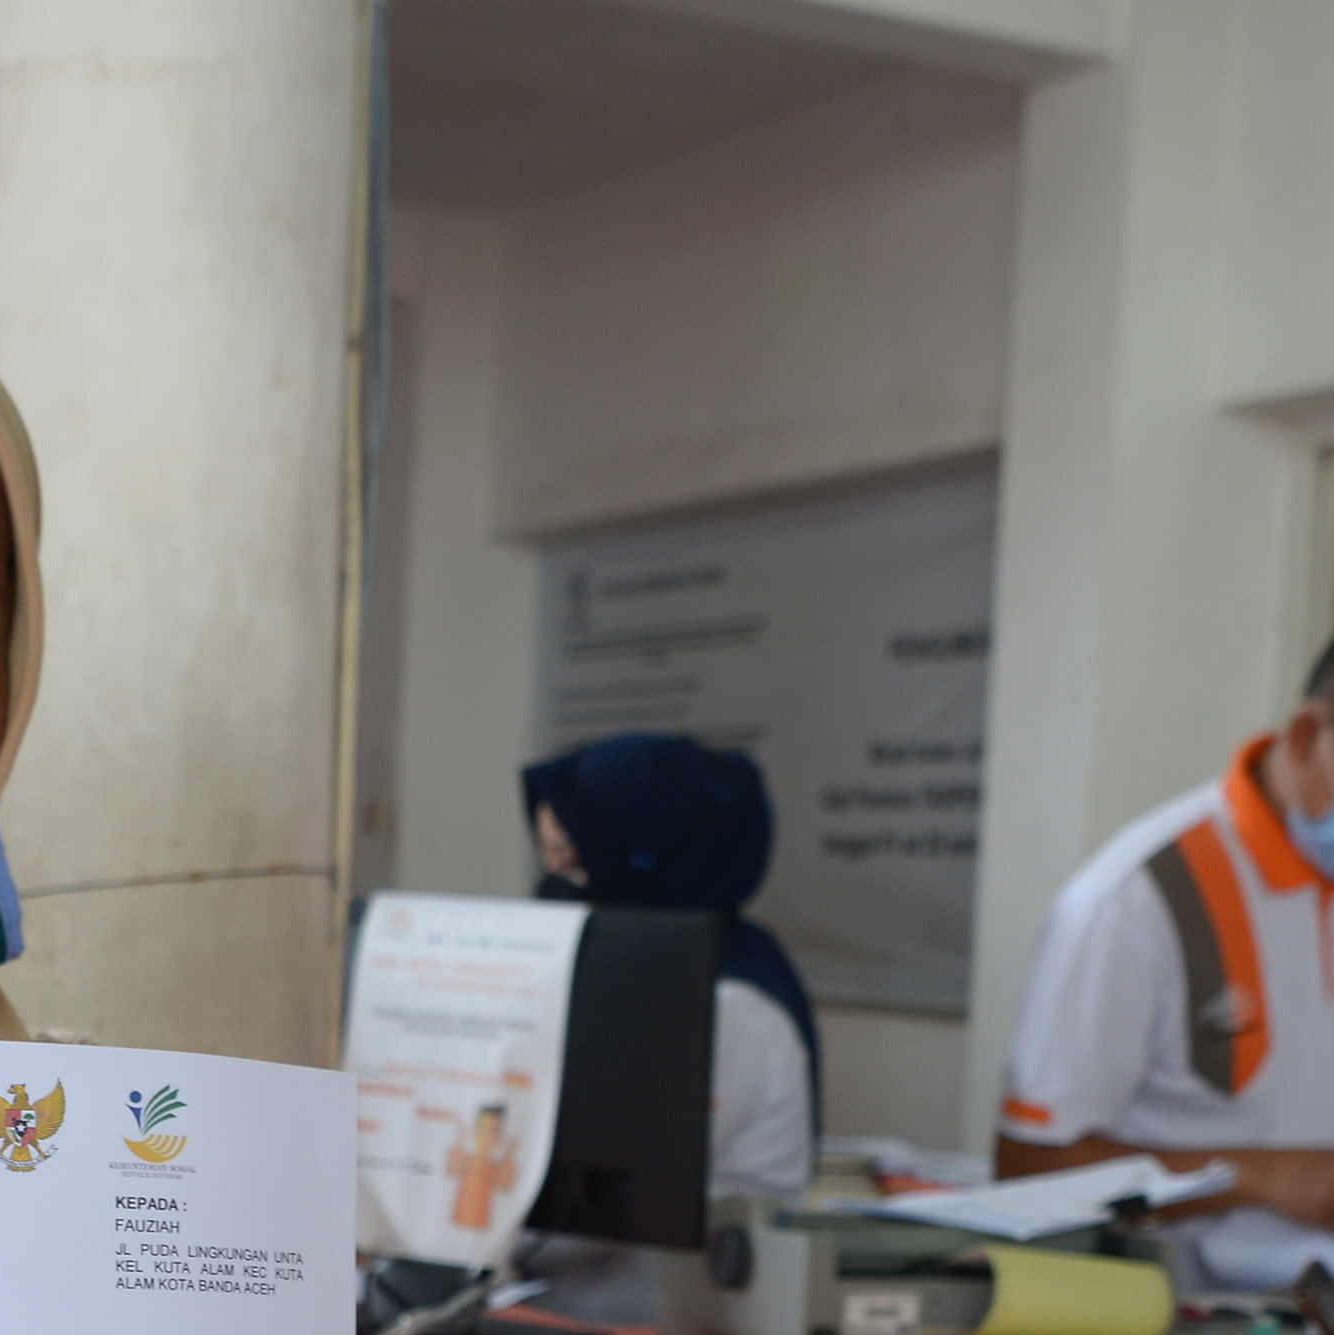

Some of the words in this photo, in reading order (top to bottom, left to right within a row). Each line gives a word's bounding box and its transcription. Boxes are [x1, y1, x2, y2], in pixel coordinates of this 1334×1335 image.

[115, 1196, 178, 1211] KEPADA
[115, 1219, 180, 1234] FAUZIAH
[115, 1243, 131, 1256] JL
[140, 1244, 179, 1257] PUDA
[187, 1246, 267, 1262] LINGKUNGAN
[274, 1251, 304, 1265] UNTA
[115, 1260, 143, 1273] KEL
[154, 1261, 191, 1274] KUTA
[200, 1264, 234, 1277] ALAM
[243, 1266, 267, 1279] KEC
[274, 1268, 304, 1281] KUTA
[115, 1278, 155, 1290] ALAM
[158, 1278, 196, 1292] KOTA
[199, 1280, 242, 1294] BANDA
[243, 1282, 276, 1296] ACEH
